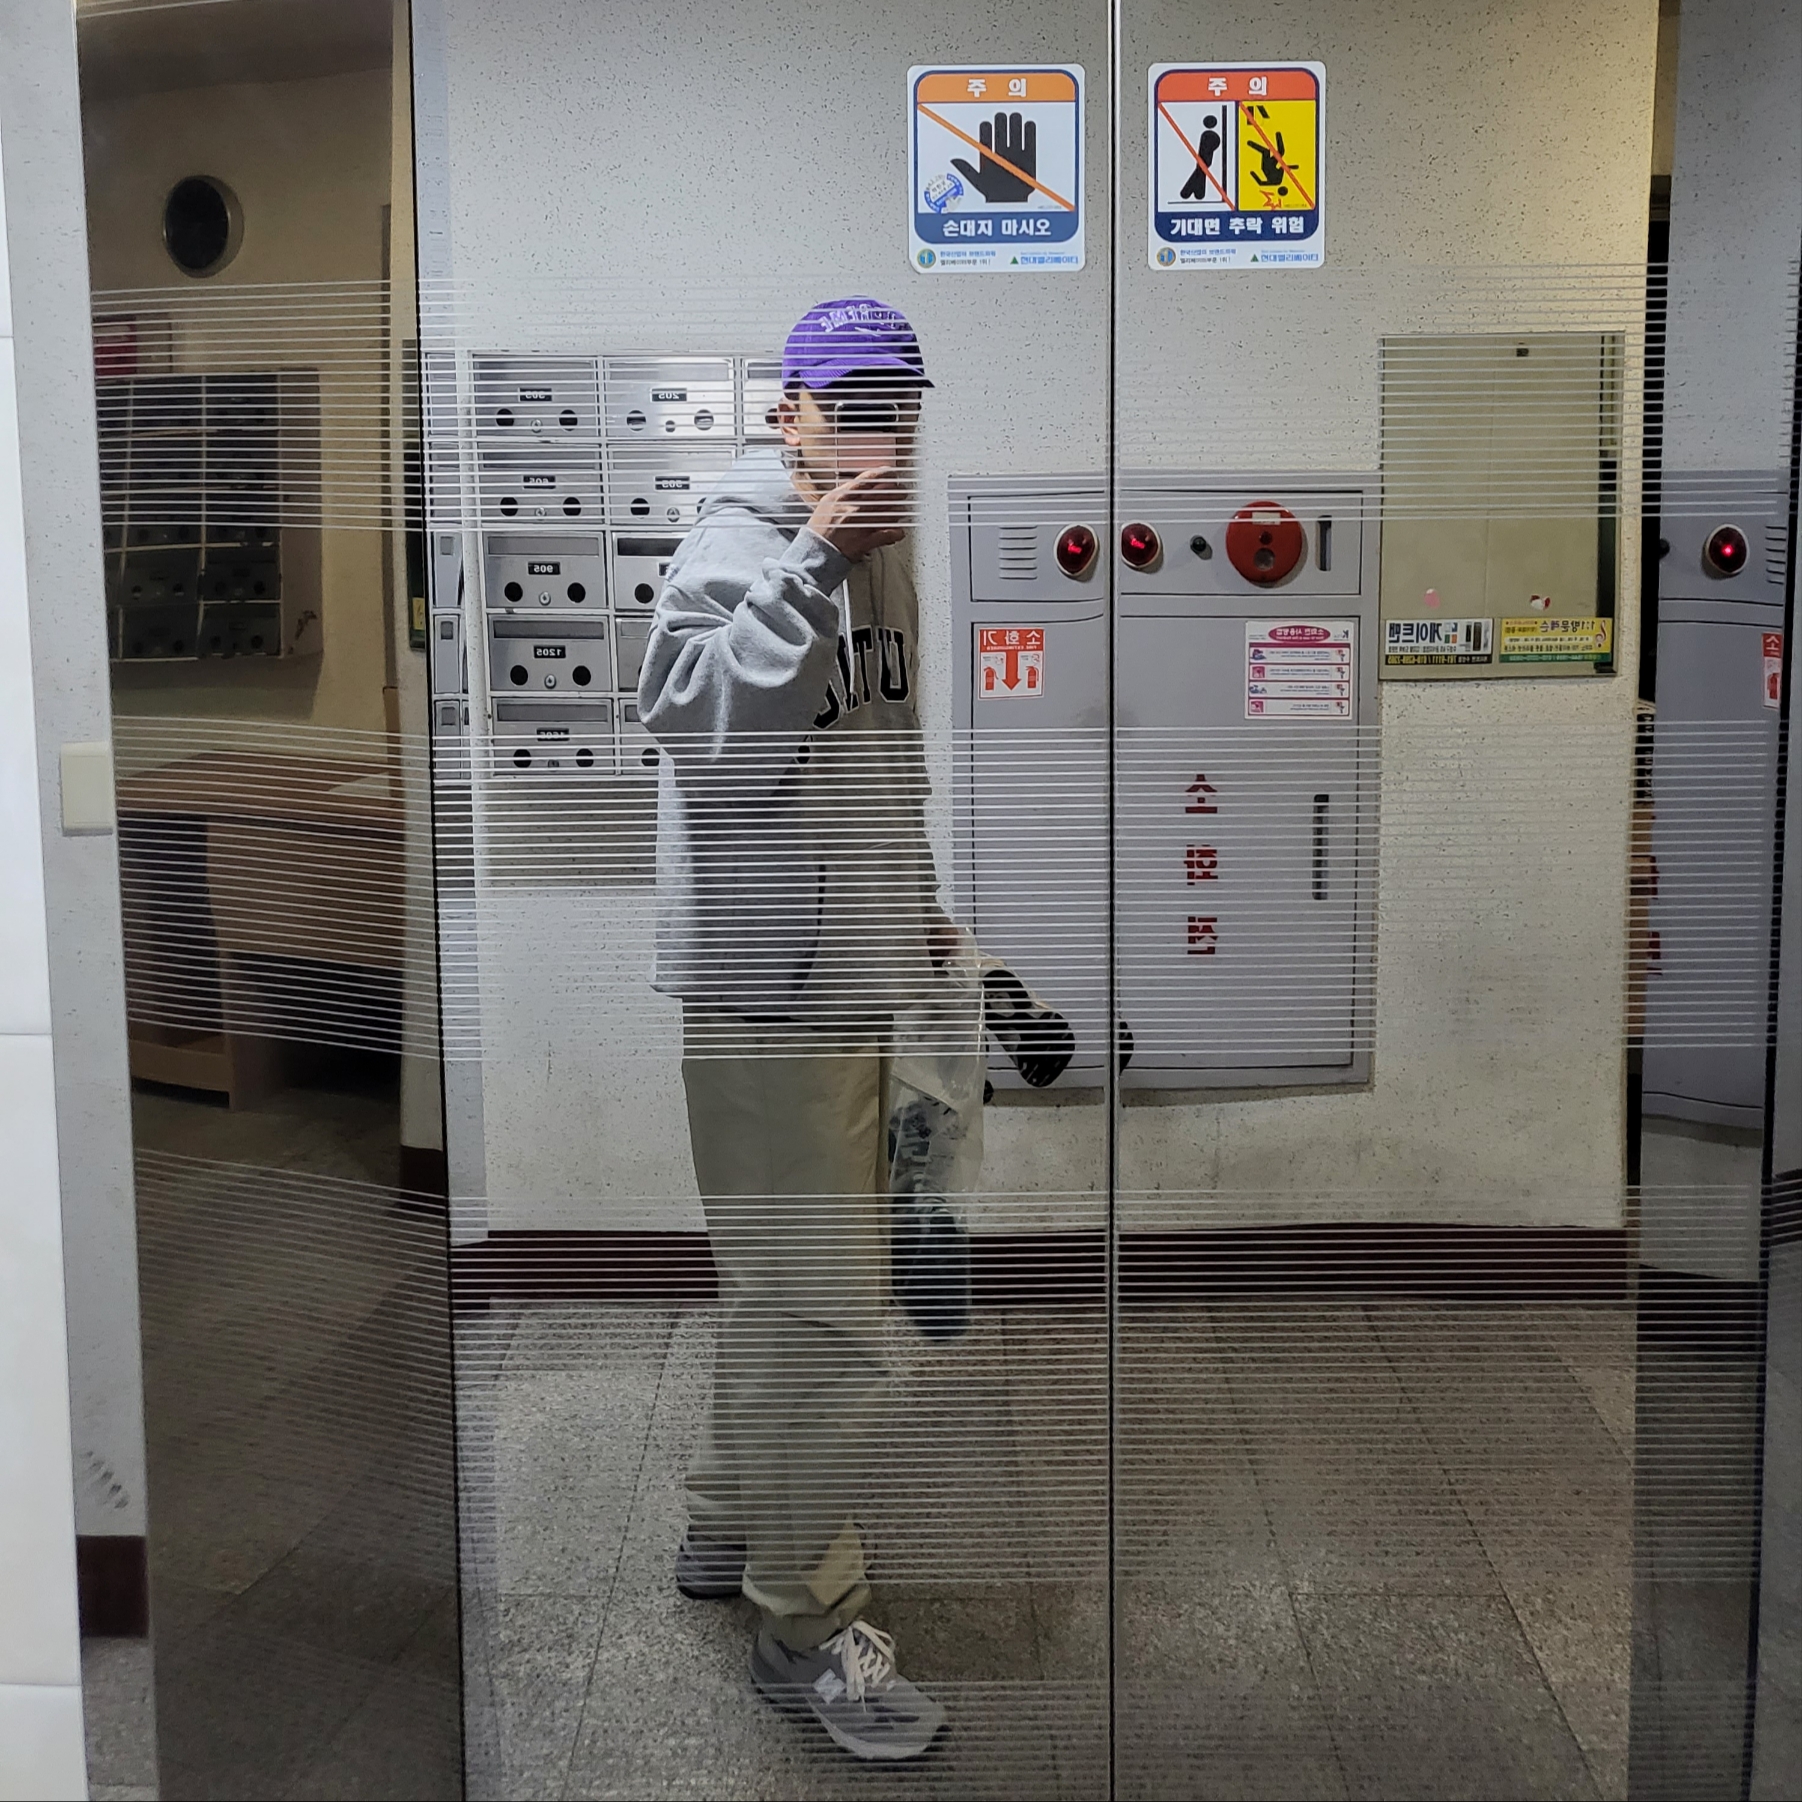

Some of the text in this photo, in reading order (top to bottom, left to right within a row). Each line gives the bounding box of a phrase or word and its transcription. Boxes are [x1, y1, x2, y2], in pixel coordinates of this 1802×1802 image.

[942, 218, 1052, 237] 손대지 마시오
[1170, 216, 1305, 236] 기대면 추락 위험
[1020, 255, 1079, 265] 현대엘리베이터
[1260, 253, 1319, 263] 현대엘리베이터
